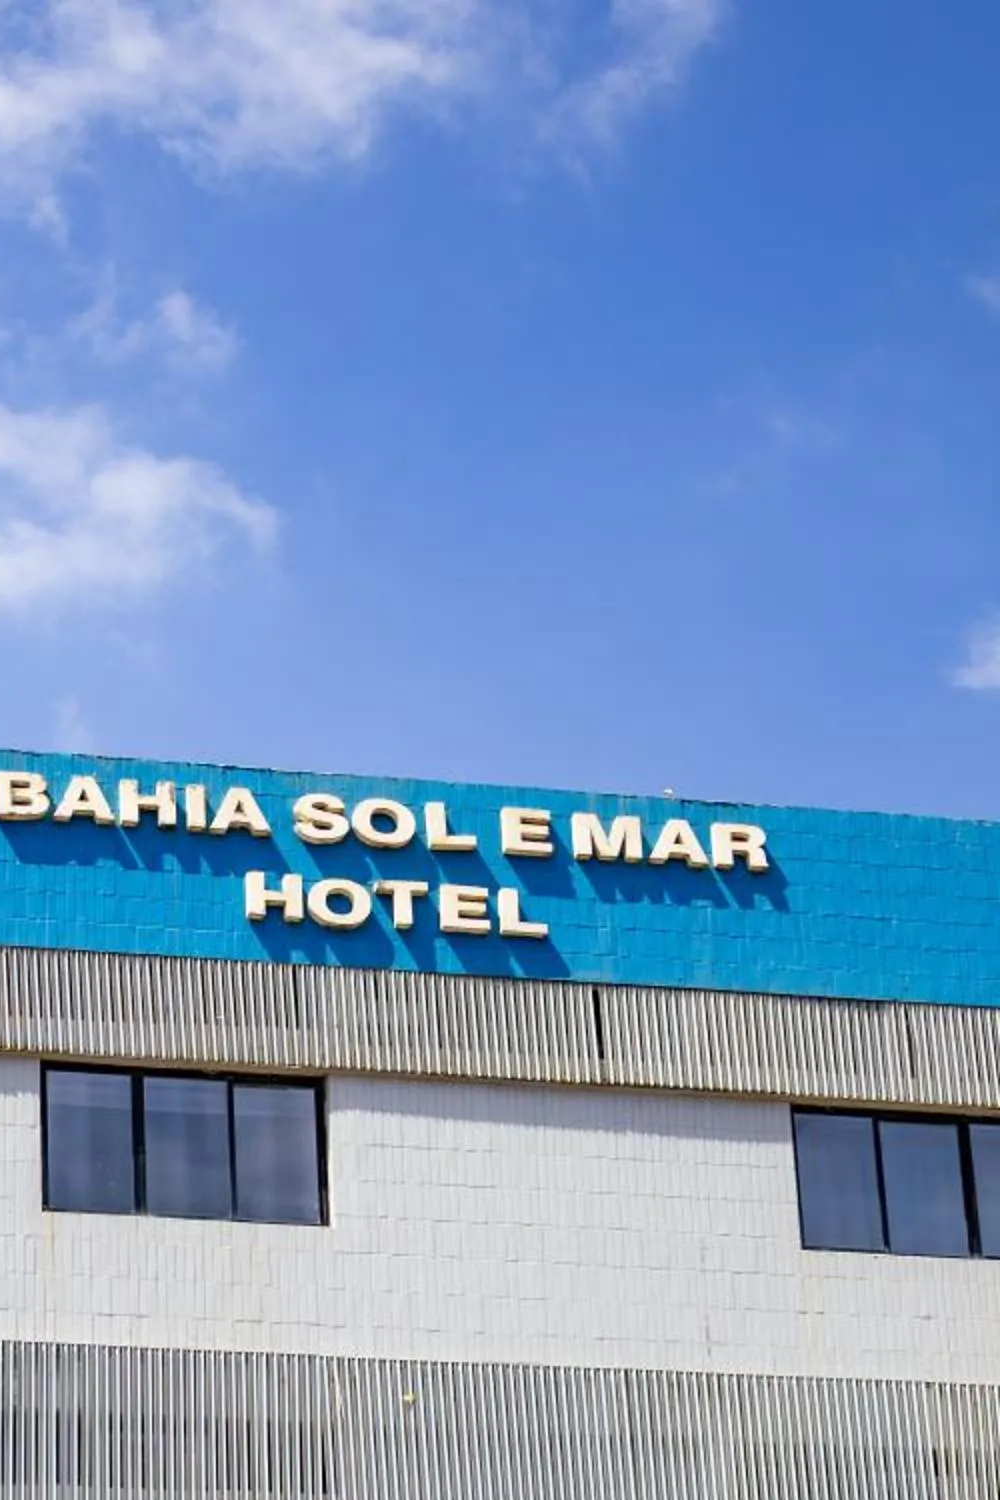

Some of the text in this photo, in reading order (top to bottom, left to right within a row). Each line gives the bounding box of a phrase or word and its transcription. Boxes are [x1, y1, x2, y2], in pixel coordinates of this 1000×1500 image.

[293, 793, 476, 852] SOL
[501, 806, 554, 857] E
[571, 812, 768, 872] MAR
[245, 871, 549, 938] HOTEL
